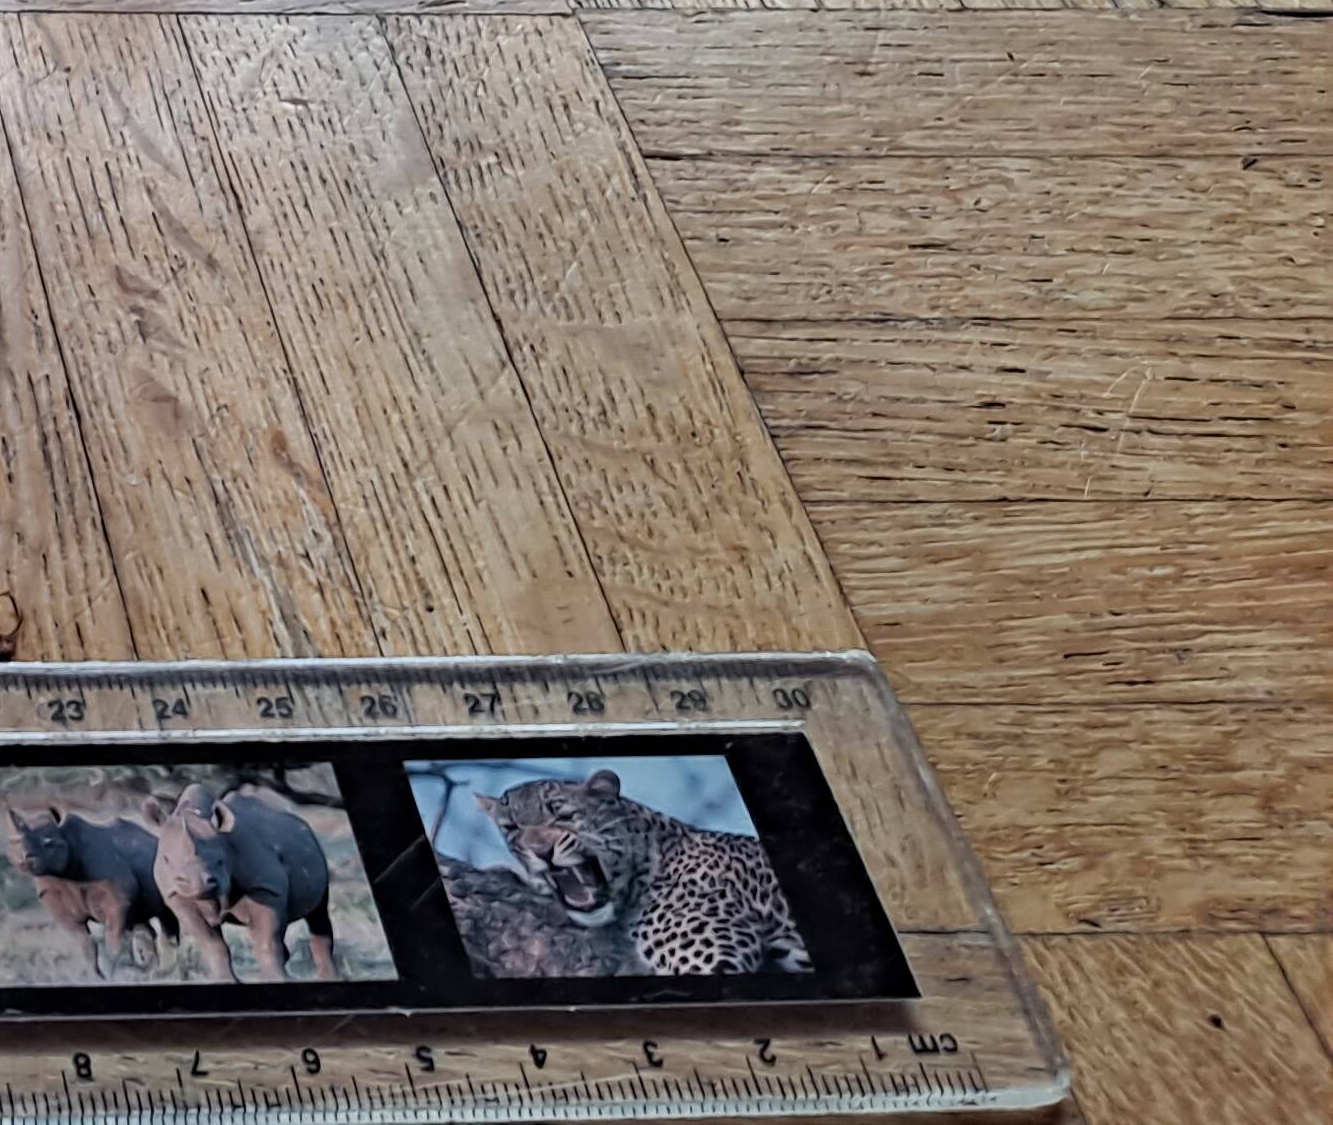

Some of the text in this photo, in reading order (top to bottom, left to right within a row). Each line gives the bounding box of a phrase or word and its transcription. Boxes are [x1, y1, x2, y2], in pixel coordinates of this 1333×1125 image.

[47, 700, 86, 721] 23
[153, 698, 190, 720] 24
[256, 697, 294, 719] 25
[360, 696, 397, 718] 26
[465, 693, 499, 713] 27
[671, 690, 708, 711] 29
[530, 1044, 547, 1069] 4
[643, 1041, 663, 1068] 3
[754, 1039, 776, 1066] 2
[872, 1036, 887, 1059] 1
[907, 1034, 958, 1054] cm
[73, 1053, 93, 1081] 8
[191, 1050, 208, 1076] 7
[301, 1048, 321, 1074] 6
[415, 1045, 434, 1071] 5
